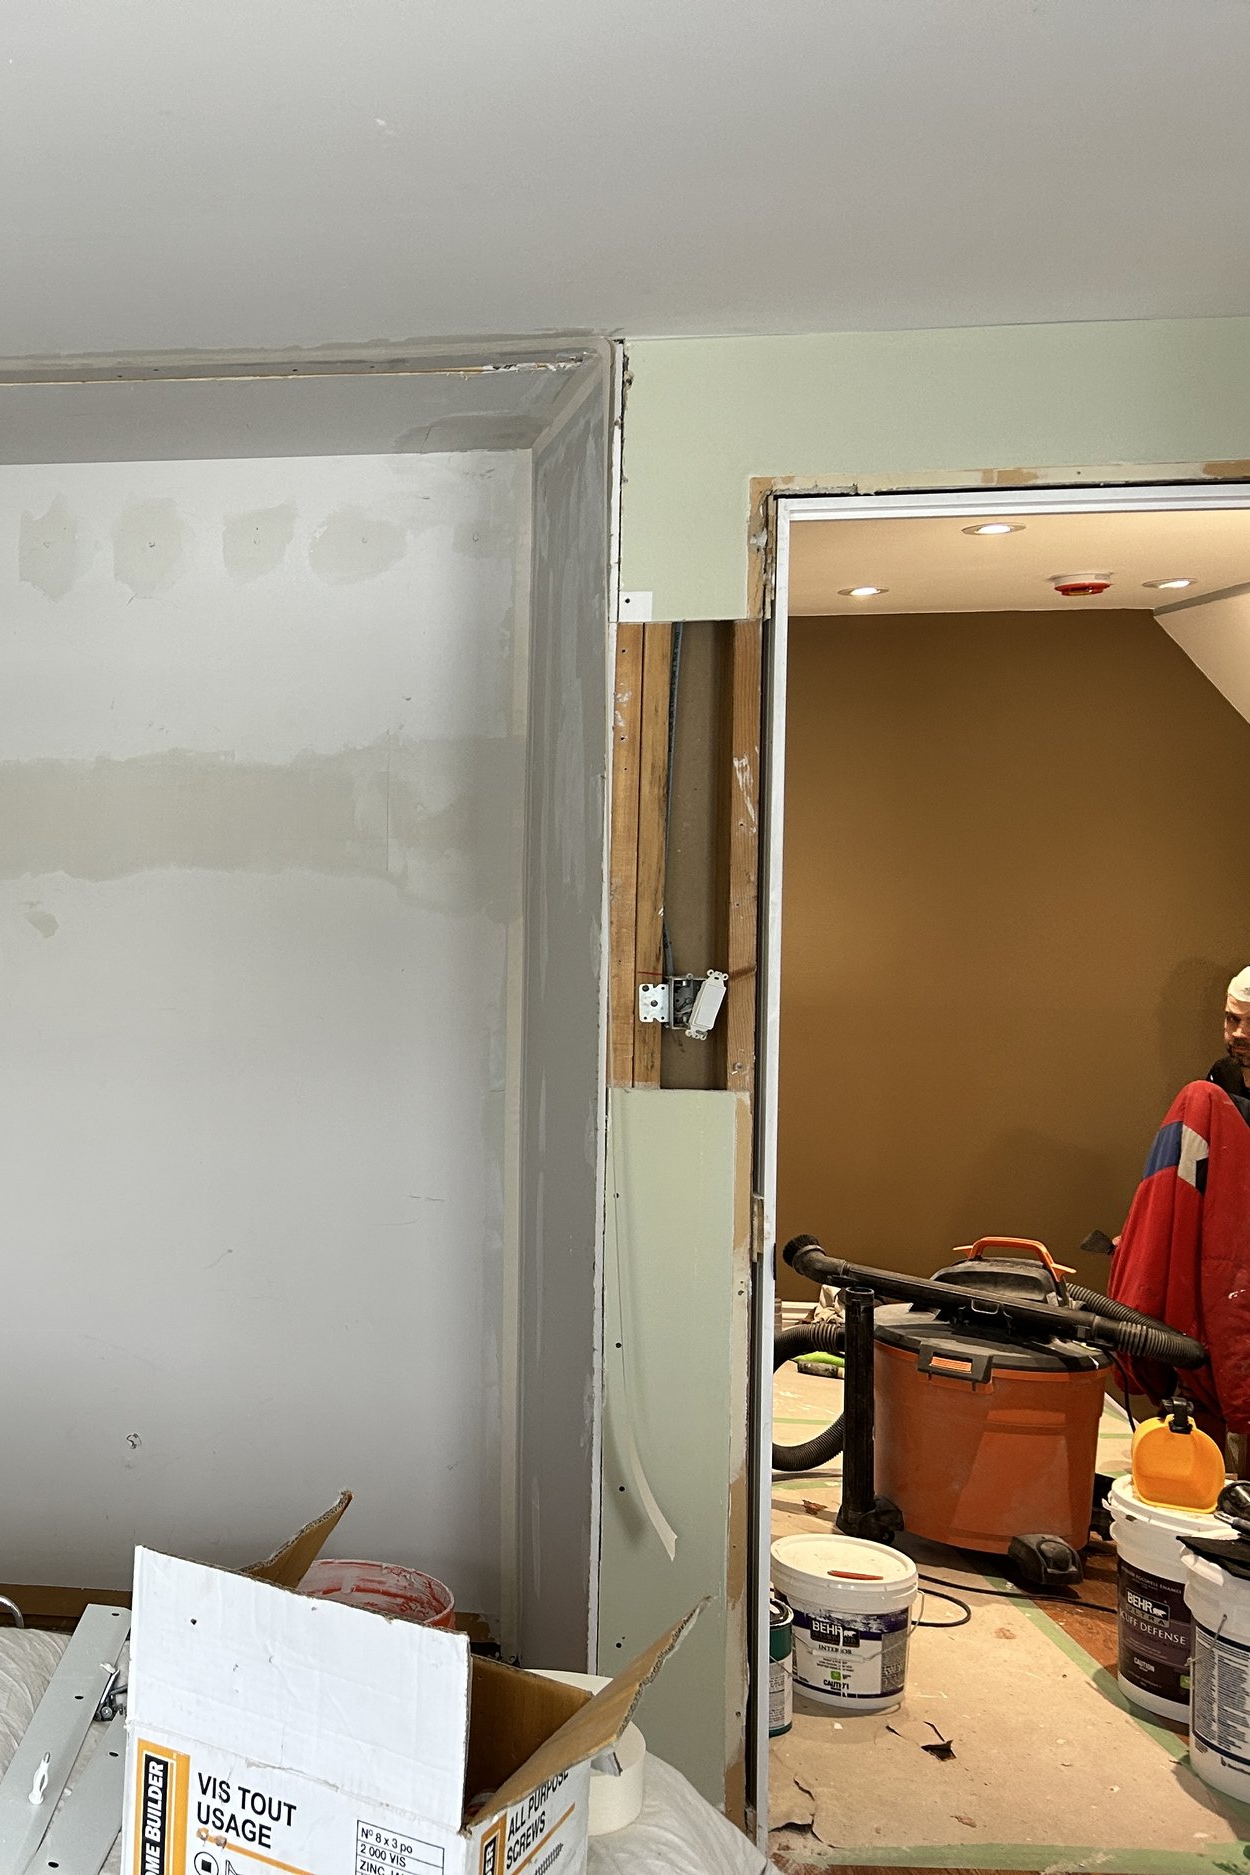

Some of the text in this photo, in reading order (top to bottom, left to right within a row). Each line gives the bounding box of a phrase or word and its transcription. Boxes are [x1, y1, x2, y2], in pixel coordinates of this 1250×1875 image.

[1127, 1591, 1153, 1614] BEHR
[1140, 1622, 1186, 1646] DEFENSE
[145, 1760, 164, 1842] BUILDER
[197, 1772, 297, 1827] VIS TOUT
[197, 1801, 272, 1849] USAGE
[508, 1806, 526, 1842] ALL
[375, 1832, 382, 1844] 8
[383, 1837, 390, 1846] x
[391, 1838, 398, 1849] 3
[400, 1843, 413, 1854] po
[506, 1810, 546, 1870] SCREWS
[359, 1859, 385, 1875] ZINC
[360, 1843, 406, 1868] 2 000 VIS
